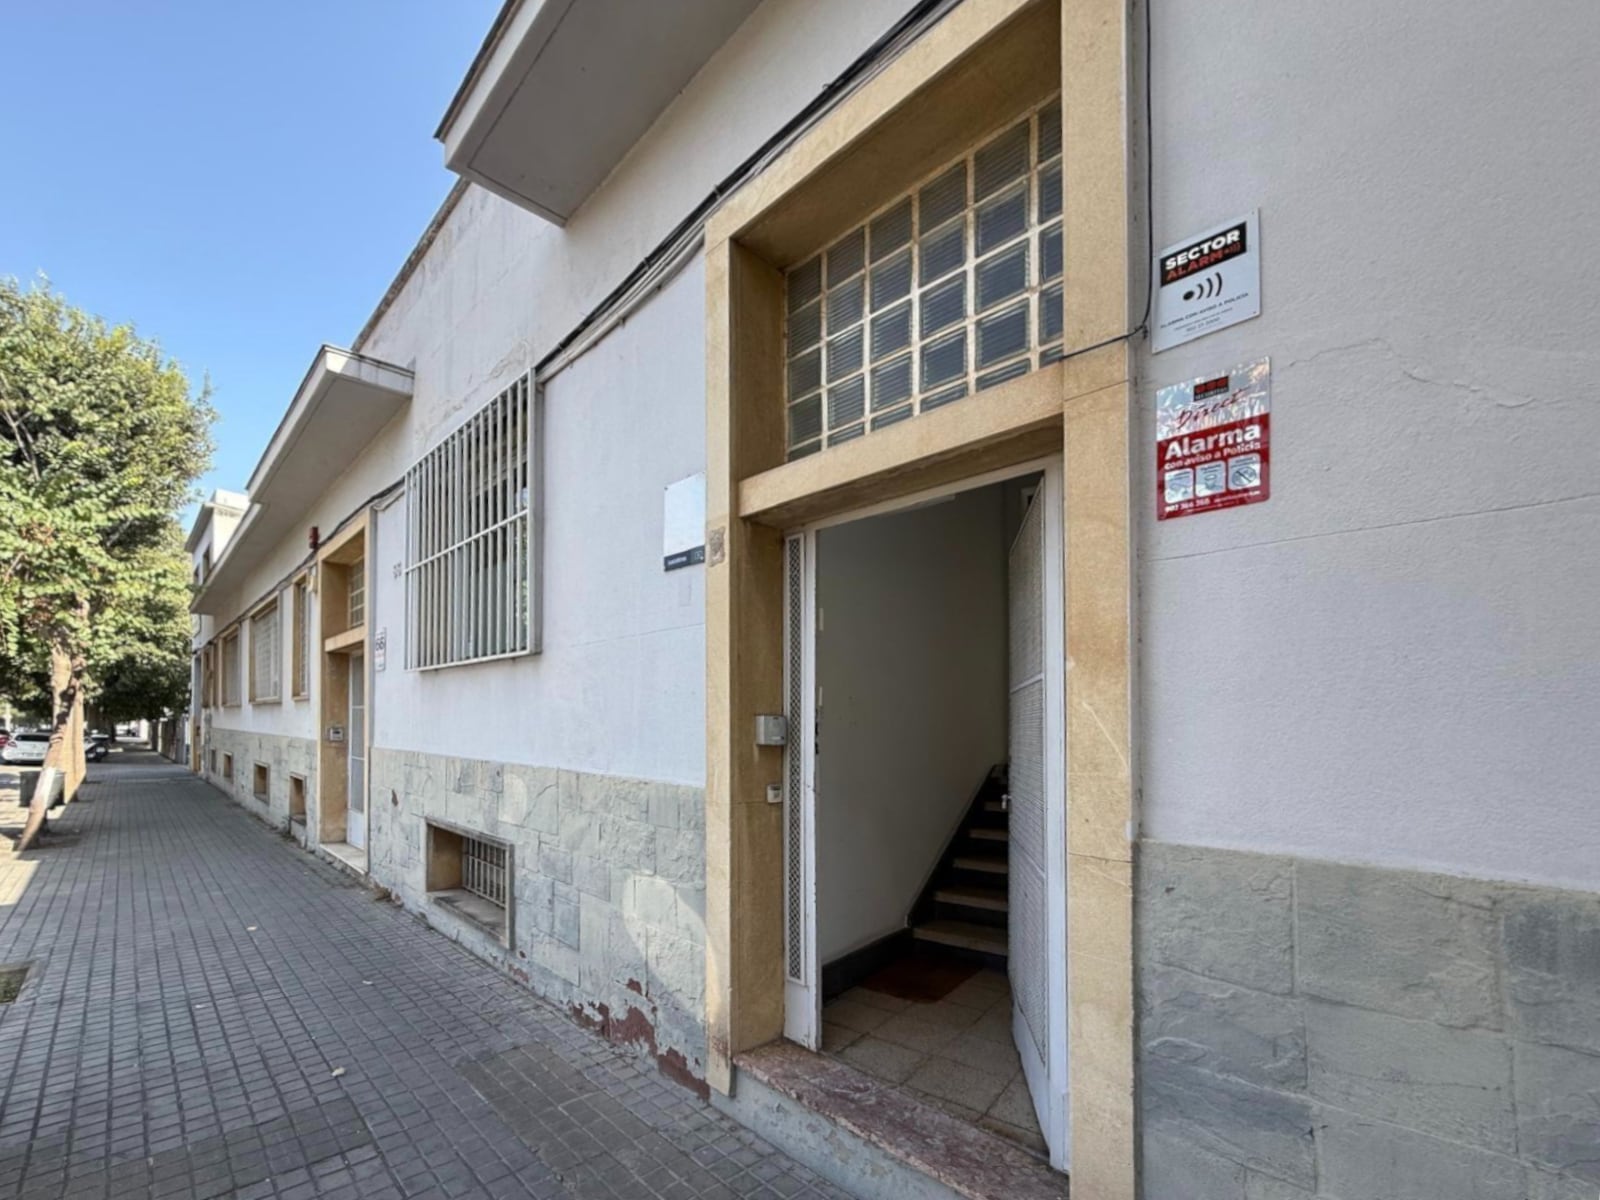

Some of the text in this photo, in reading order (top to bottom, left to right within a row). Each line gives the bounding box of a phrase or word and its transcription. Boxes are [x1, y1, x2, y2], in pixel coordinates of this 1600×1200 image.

[1165, 229, 1240, 270] SECTOR
[1166, 250, 1224, 281] ALARM
[1176, 386, 1250, 430] Direct
[1164, 423, 1261, 461] Alarma
[1164, 459, 1183, 470] con
[1184, 452, 1213, 466] aviso
[1214, 450, 1222, 459] a
